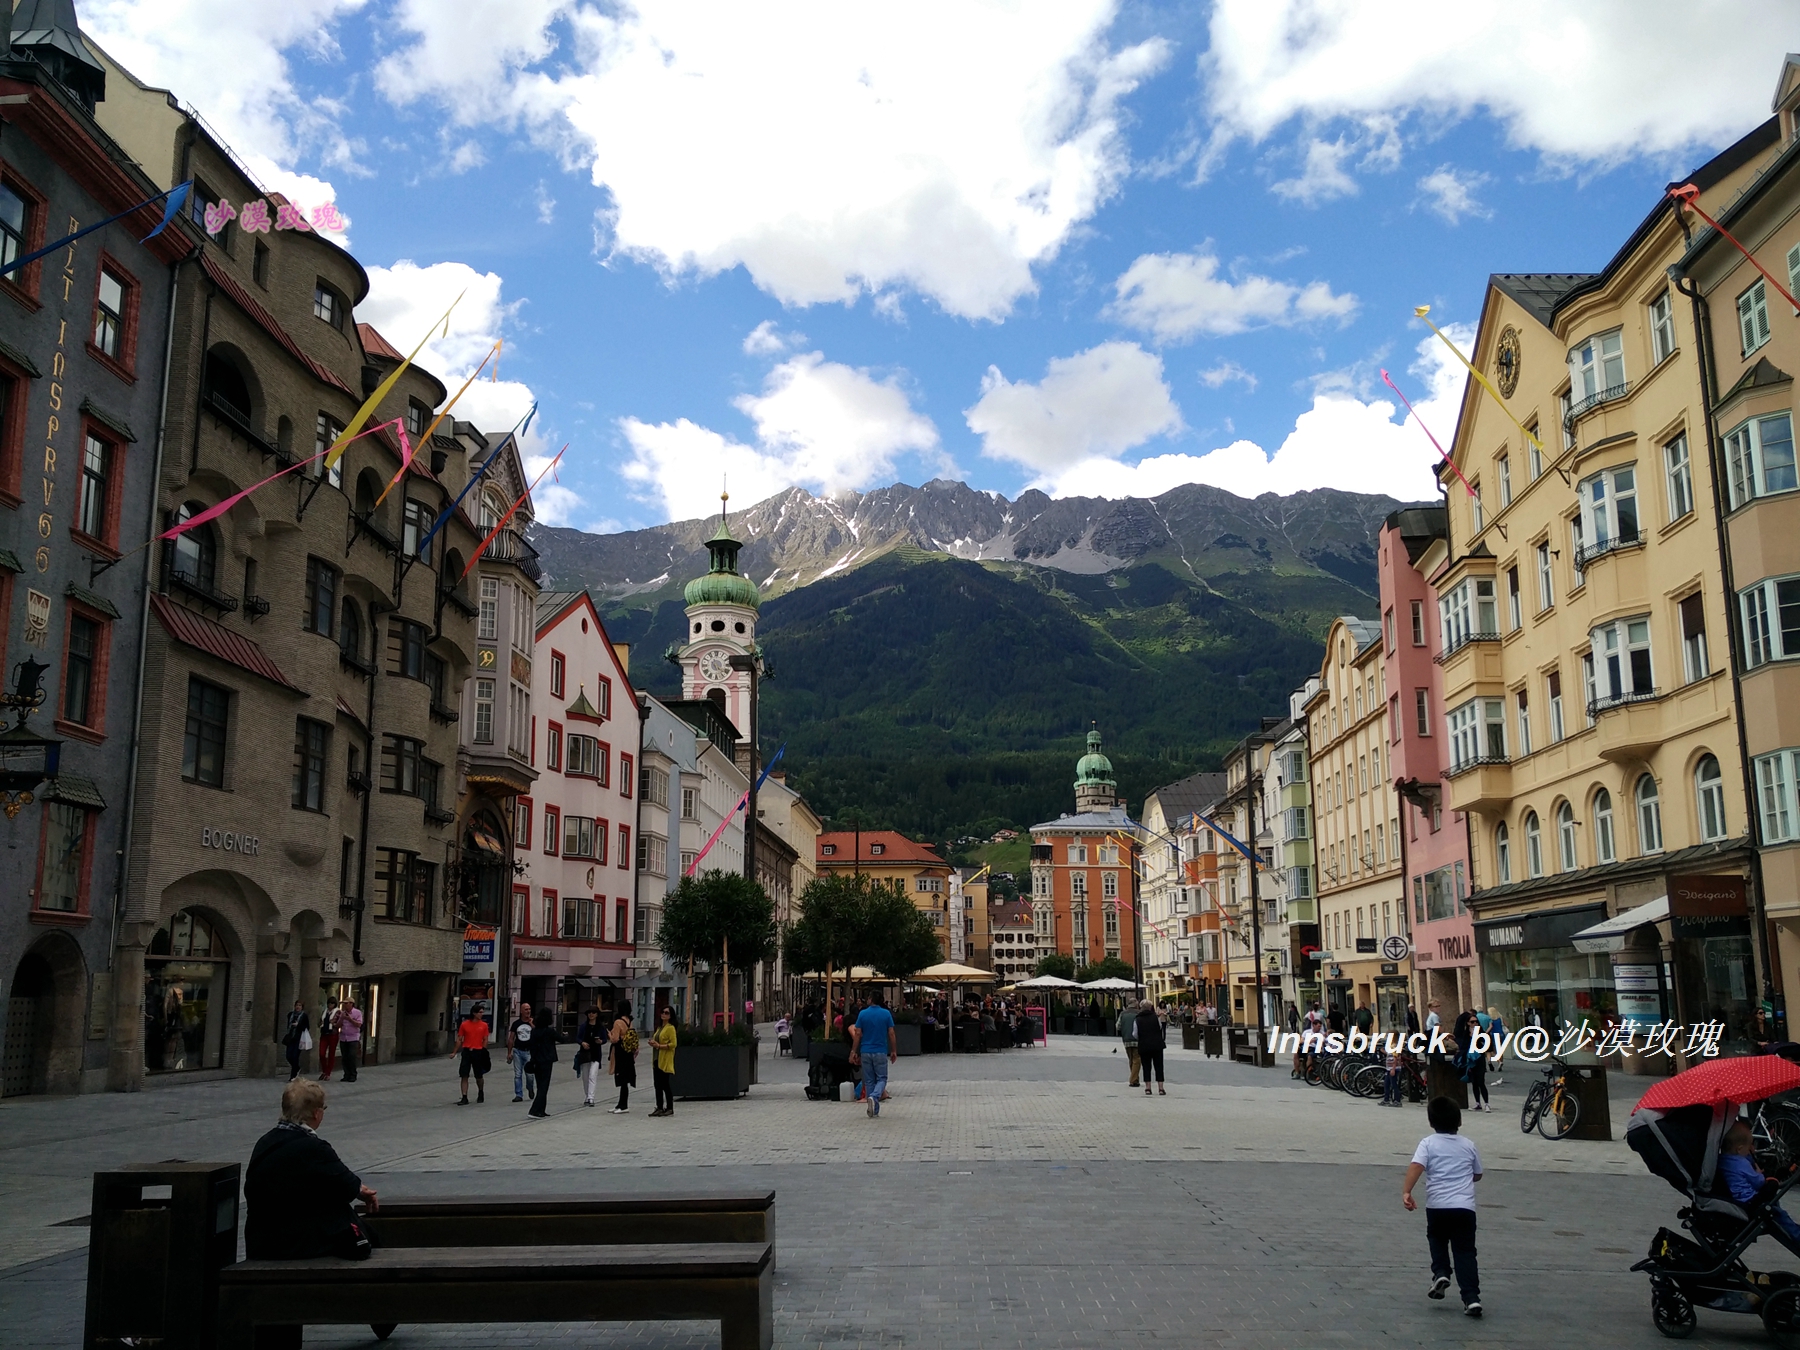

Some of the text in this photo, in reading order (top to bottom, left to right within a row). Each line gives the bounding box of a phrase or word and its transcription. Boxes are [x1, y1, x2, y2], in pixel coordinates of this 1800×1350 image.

[202, 827, 260, 856] BOGNER
[1677, 889, 1738, 902] Weigand
[1488, 926, 1523, 947] HUMANIC
[464, 941, 490, 954] SEGAAR
[1437, 934, 1472, 961] TYROLIA
